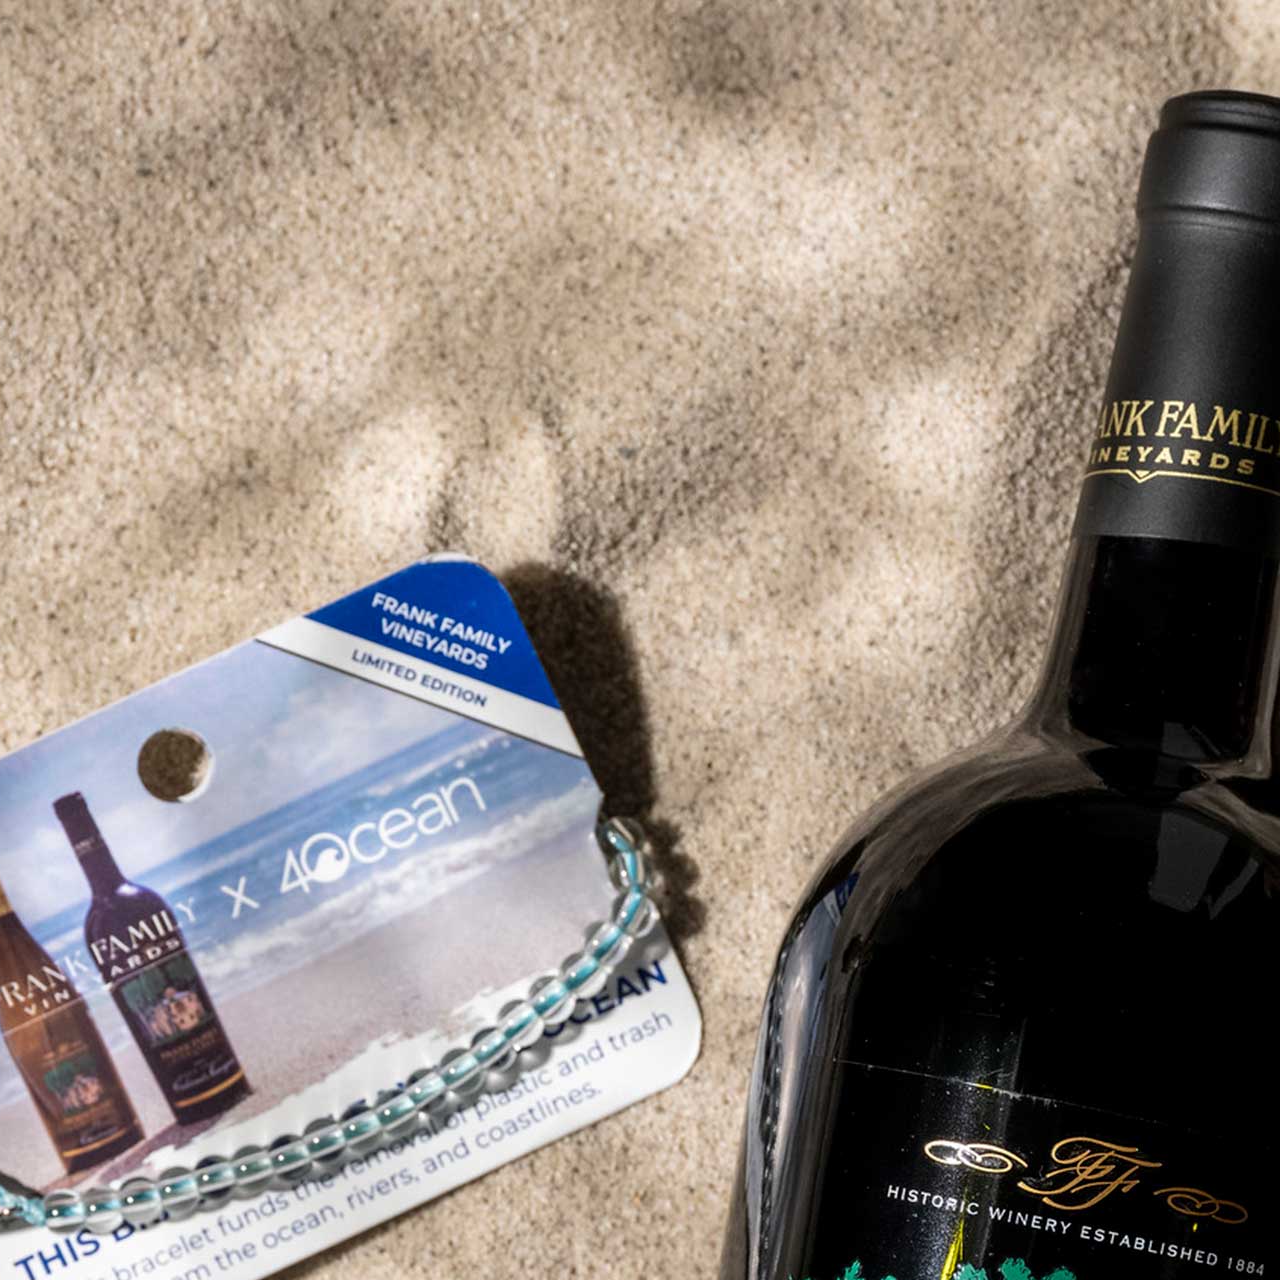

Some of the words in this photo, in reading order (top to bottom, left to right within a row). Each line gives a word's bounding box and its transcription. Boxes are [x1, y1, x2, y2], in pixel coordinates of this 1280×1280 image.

[372, 592, 439, 629] FRANK
[440, 617, 512, 655] FAMILY
[381, 618, 488, 670] VINEYARDS
[352, 650, 417, 681] LIMITED
[420, 674, 488, 707] EDITION
[90, 898, 197, 964] FAMILY
[216, 1192, 290, 1236] funds
[292, 1171, 336, 1201] the
[339, 1116, 438, 1179] removal
[474, 1067, 552, 1120] plastic
[558, 1041, 605, 1077] and
[609, 1010, 672, 1051] trash
[214, 1240, 258, 1273] the
[262, 1205, 344, 1249] ocean,
[347, 1167, 420, 1209] rivers,
[422, 1138, 470, 1174] and
[475, 1080, 601, 1149] coastlines.
[887, 1184, 980, 1216] HISTORIC
[988, 1205, 1072, 1235] WINERY
[1080, 1225, 1219, 1267] ESTABLISHED
[1227, 1257, 1265, 1276] 1884
